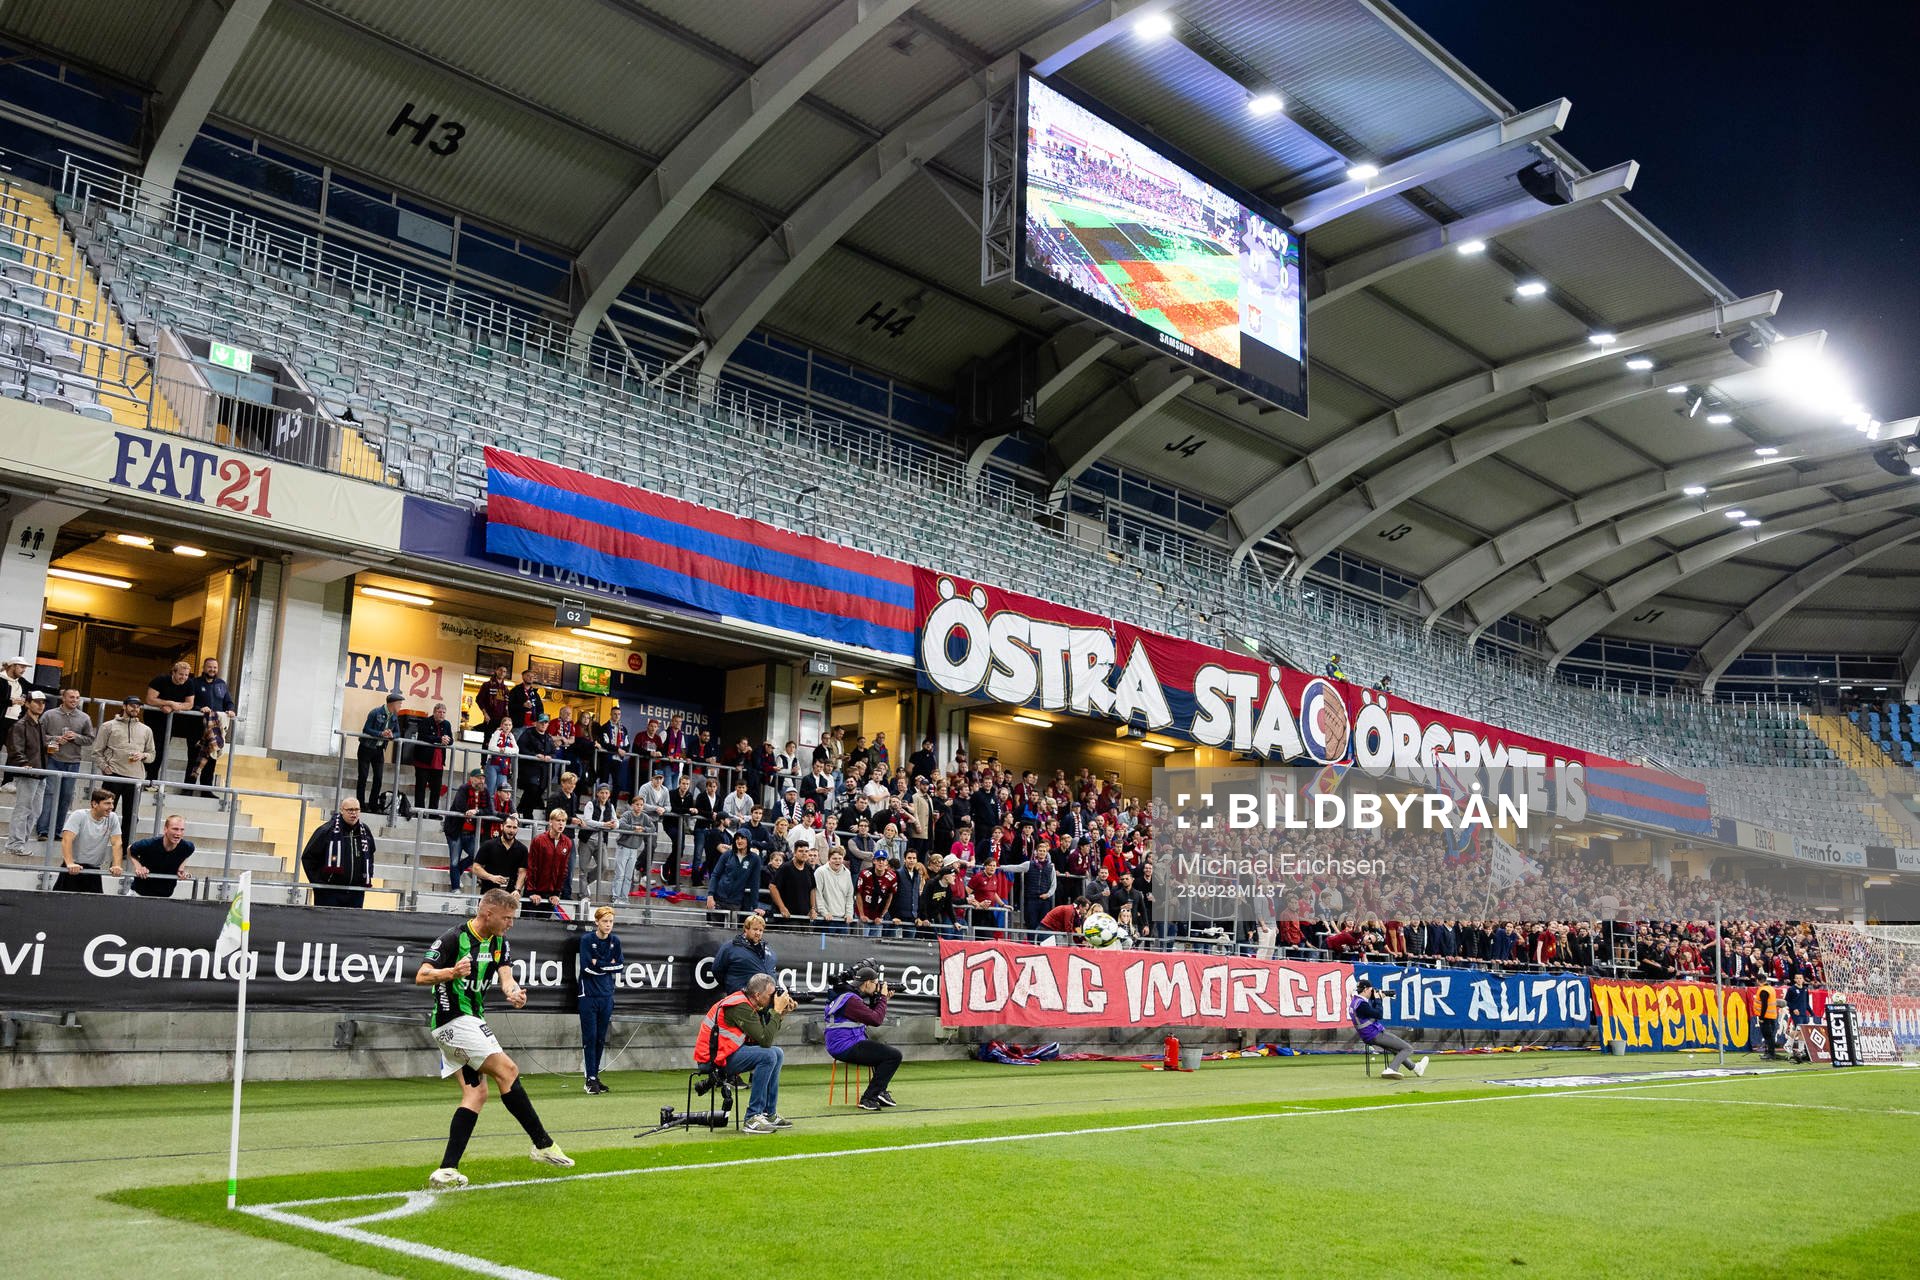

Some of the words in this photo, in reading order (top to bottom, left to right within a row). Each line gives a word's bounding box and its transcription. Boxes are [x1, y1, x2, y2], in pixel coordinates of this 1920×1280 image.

[386, 102, 467, 157] H3
[856, 302, 917, 338] H4
[1159, 332, 1195, 357] SAMSUNG
[275, 407, 303, 447] H3
[1165, 434, 1207, 458] J4
[109, 431, 273, 519] FAT21
[1378, 523, 1412, 542] J3
[566, 611, 581, 622] G2
[1633, 609, 1665, 624] J1
[344, 651, 444, 701] FAT21
[817, 662, 830, 673] G3
[921, 576, 1175, 732] ÖSTRA
[1188, 664, 1306, 762] STÅ
[640, 703, 709, 726] LEGENDENS
[1353, 688, 1549, 815] ÖRGRYTE
[1551, 756, 1589, 823] IS
[83, 934, 259, 981] Gamla
[274, 941, 405, 984] Ullevi
[943, 949, 1108, 1015] IDAG
[1381, 967, 1456, 1020] FÖR
[1592, 982, 1749, 1049] INFERNO
[1829, 1012, 1850, 1061] SELECT
